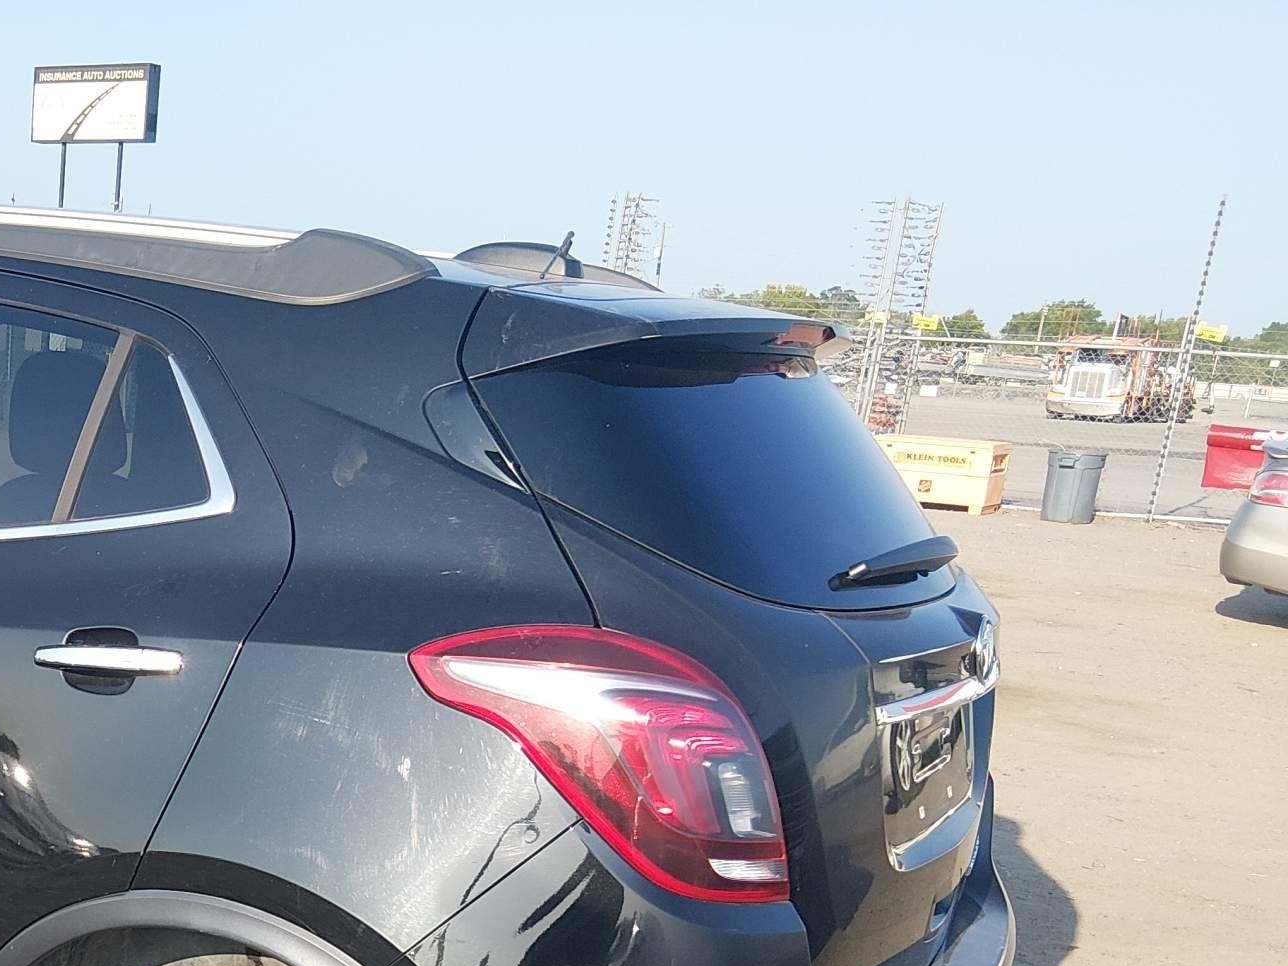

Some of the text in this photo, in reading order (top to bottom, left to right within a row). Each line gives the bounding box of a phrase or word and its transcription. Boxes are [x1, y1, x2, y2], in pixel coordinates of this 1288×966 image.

[39, 69, 144, 82] INSURANCE AUTO AUCTIONS
[906, 453, 967, 464] KLEIN TOOLS
